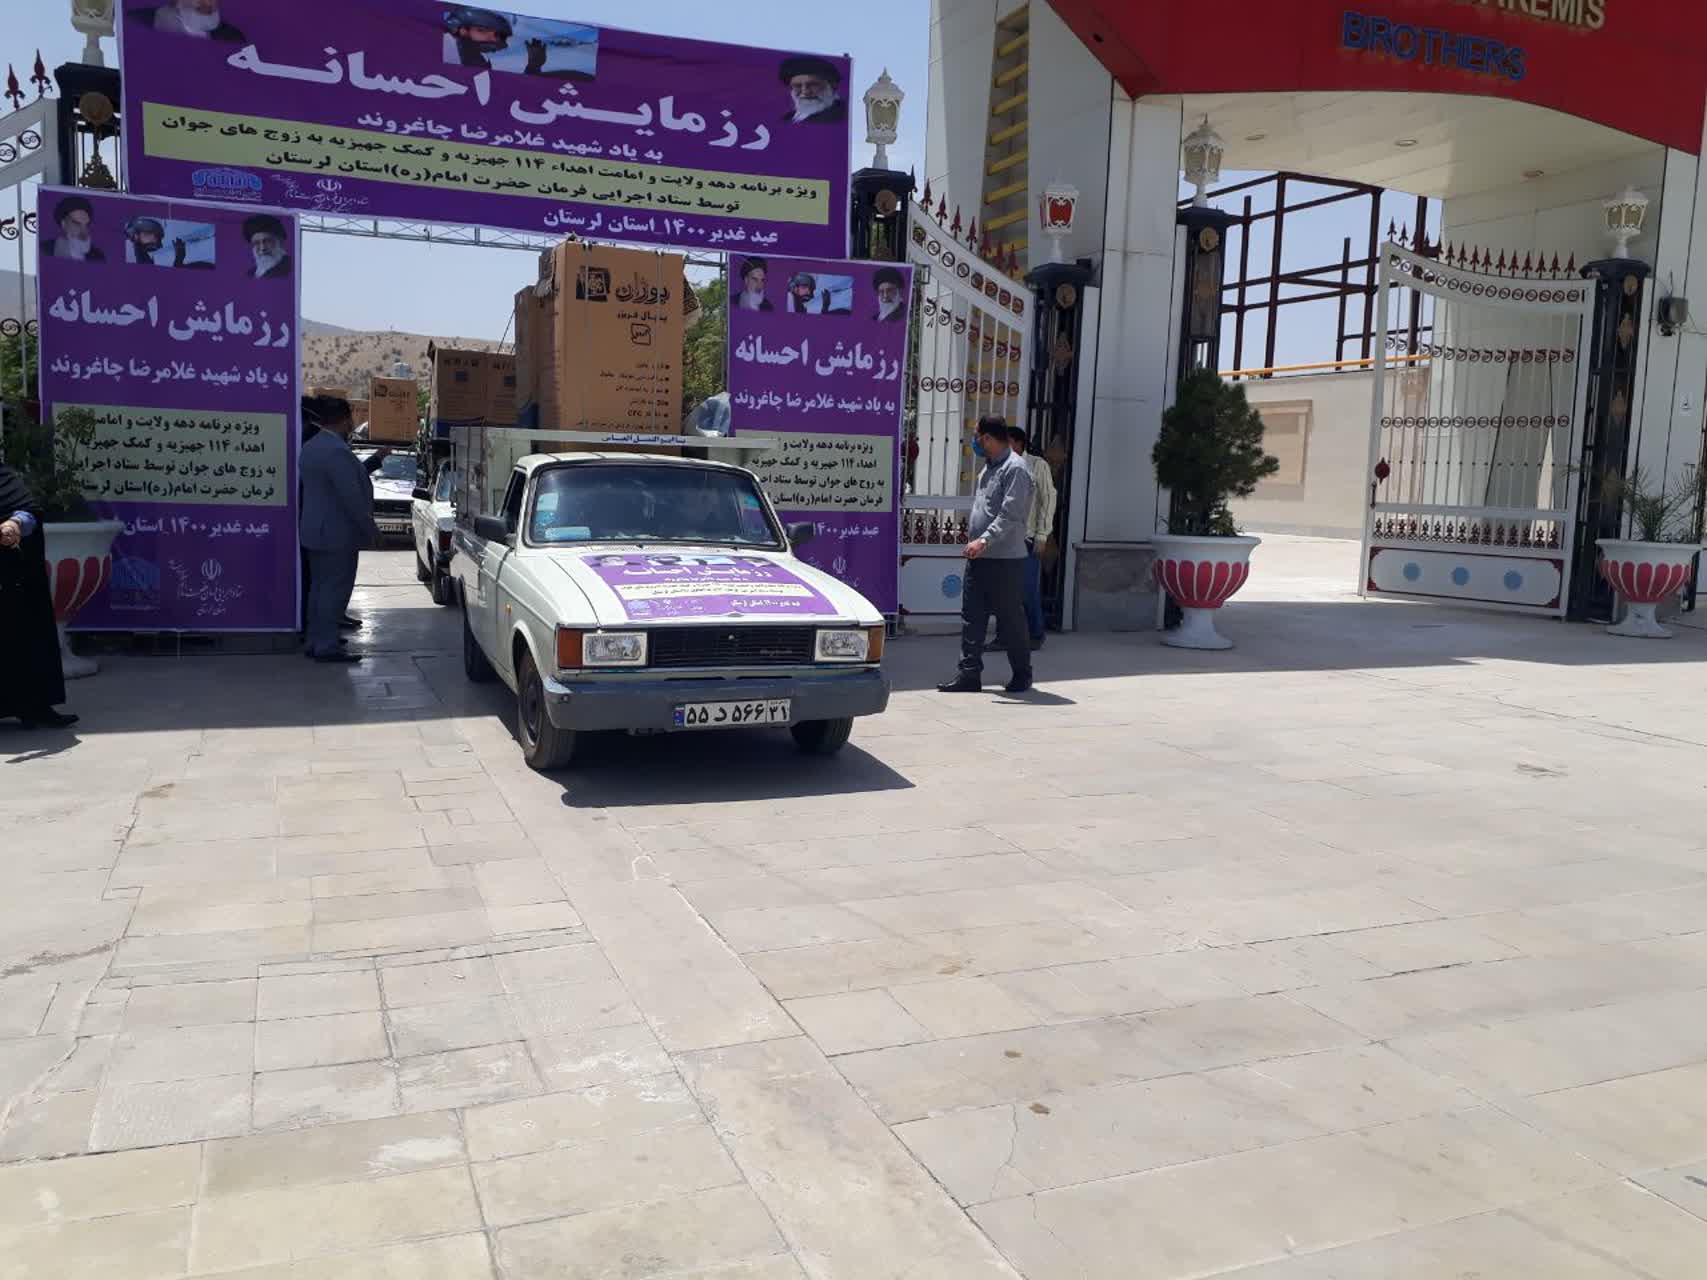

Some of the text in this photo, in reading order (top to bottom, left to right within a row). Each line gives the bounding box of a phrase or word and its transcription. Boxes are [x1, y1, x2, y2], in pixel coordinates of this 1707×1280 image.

[1343, 12, 1527, 80] BROTHERS
[227, 44, 770, 150] رزمایش احسانه
[162, 116, 213, 133] جوان
[220, 123, 257, 136] های
[264, 128, 301, 143] زوج
[307, 133, 322, 145] به
[356, 111, 664, 163] به یاد شهید غلامرضا چاغروند
[329, 135, 387, 154] جهیزیه
[393, 143, 435, 157] کمک
[266, 150, 331, 169] لرستان
[442, 152, 449, 161] و
[455, 151, 509, 168] جهیزیه
[552, 162, 593, 174] اهداء
[598, 167, 643, 180] امامت
[474, 174, 531, 190] حضرت
[649, 175, 656, 184] و
[661, 174, 703, 189] ولایت
[708, 180, 735, 190] دهه
[538, 182, 587, 197] فرمان
[593, 189, 652, 203] اجرایی
[740, 182, 781, 196] برنامه
[786, 185, 817, 199] ویژه
[657, 193, 691, 206] ستاد
[697, 196, 740, 212] توسط
[544, 207, 602, 232] لرستان
[751, 231, 778, 246] عید
[49, 289, 290, 348] رزمایش احسانه
[736, 335, 899, 380] رزمایش احسانه
[129, 359, 196, 384] غلامرضا
[201, 365, 241, 387] شهید
[245, 367, 268, 388] یاد
[273, 371, 289, 390] به
[837, 397, 863, 413] شهید
[865, 396, 881, 415] یاد
[884, 399, 895, 415] به
[173, 418, 196, 430] دهه
[199, 419, 231, 433] برنامه
[235, 422, 260, 435] ویژه
[122, 437, 152, 449] کمک
[165, 440, 205, 453] جهیزیه
[114, 457, 140, 471] ستاد
[143, 461, 176, 475] توسط
[179, 462, 210, 477] جوان
[212, 463, 236, 476] های
[240, 464, 263, 478] زوج
[266, 465, 276, 478] به
[200, 483, 238, 498] حضرت
[241, 485, 274, 501] فرمان
[245, 520, 269, 537] عید
[687, 706, 709, 724] ۵۵
[732, 703, 765, 722] ۵۶۶
[769, 705, 787, 721] ۳۱
